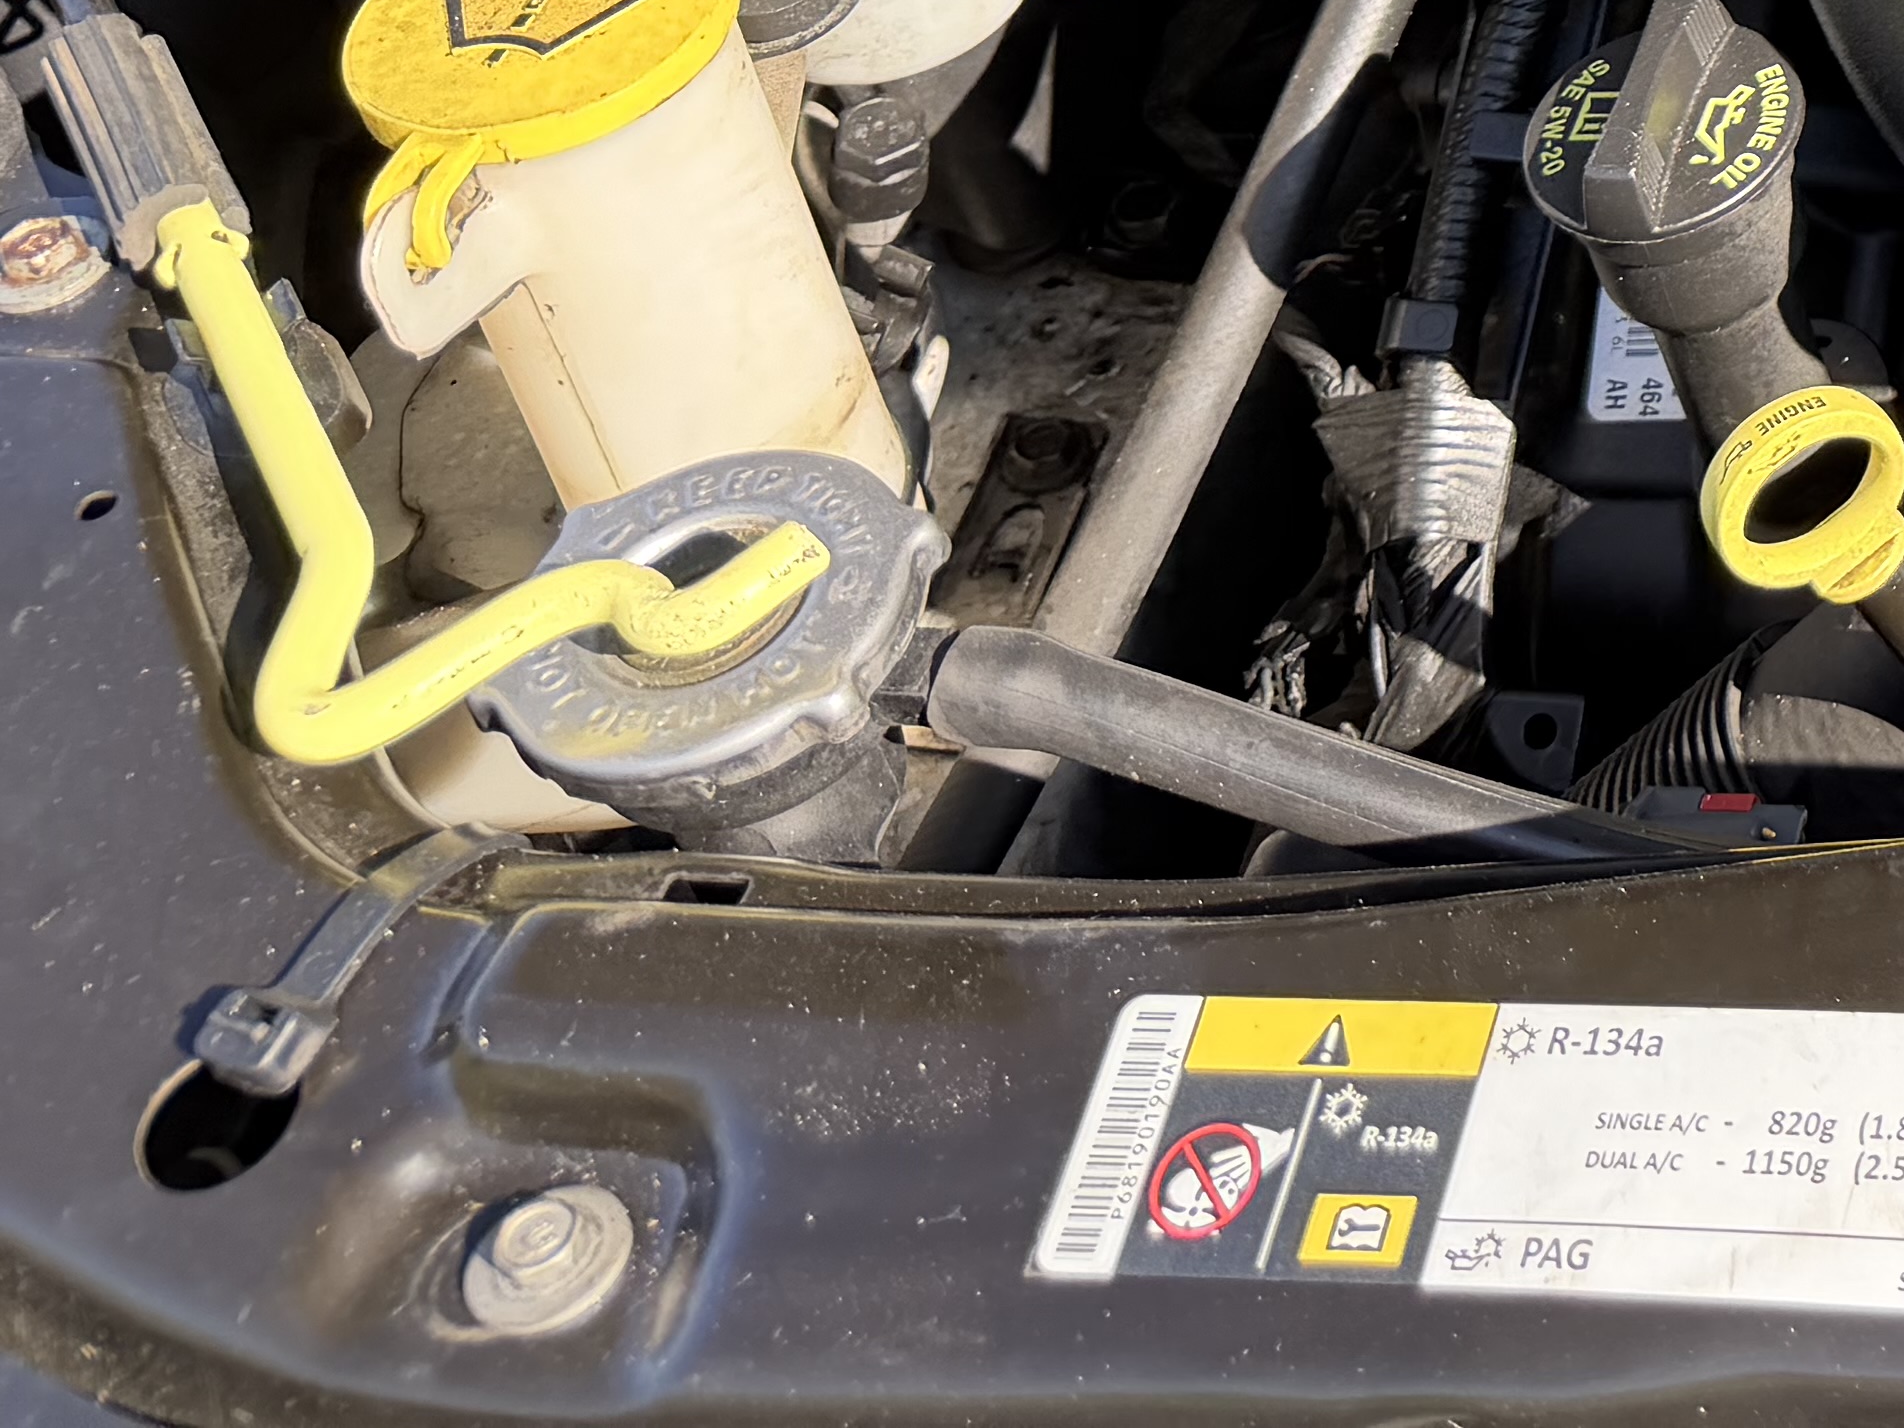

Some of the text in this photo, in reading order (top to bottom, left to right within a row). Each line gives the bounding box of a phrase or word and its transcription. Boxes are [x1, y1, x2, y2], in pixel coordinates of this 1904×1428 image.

[1540, 58, 1611, 177] SAE 5W-20
[1708, 62, 1790, 191] ENGINE OIL
[1603, 378, 1629, 410] AH
[1754, 394, 1828, 438] ENGINE
[1546, 1025, 1666, 1059] R-134a
[1109, 1045, 1184, 1222] P68190190AA
[1359, 1124, 1441, 1154] R-134a
[1593, 1111, 1666, 1133] SINGLE
[1668, 1112, 1710, 1136] A/C
[1767, 1109, 1839, 1145] 820g
[1583, 1151, 1640, 1172] DUAL
[1643, 1151, 1685, 1174] A/C
[1741, 1148, 1830, 1184] 1150g
[1519, 1237, 1595, 1271] PAG
